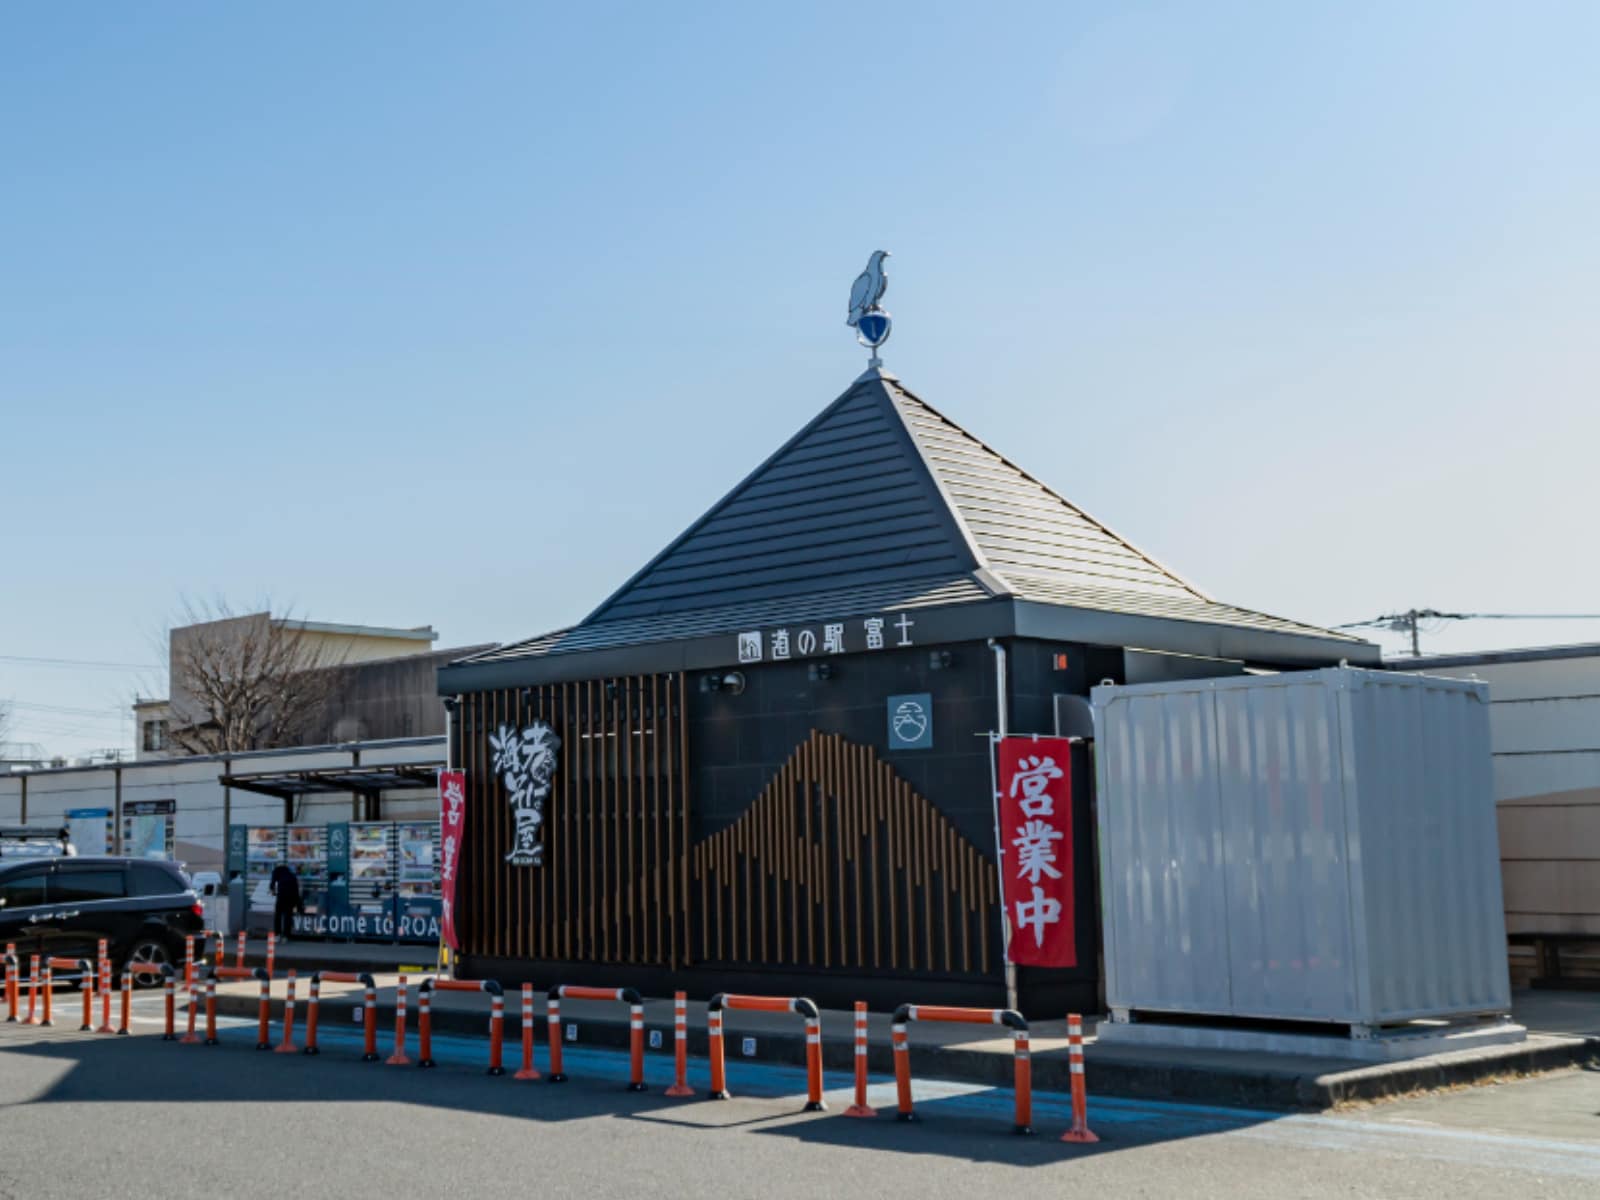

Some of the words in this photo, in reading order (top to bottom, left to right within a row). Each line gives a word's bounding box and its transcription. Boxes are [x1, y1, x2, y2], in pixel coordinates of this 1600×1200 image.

[771, 623, 846, 660] 道の駅
[863, 612, 915, 650] 富士
[1009, 755, 1065, 949] 営業中
[374, 916, 394, 935] to
[400, 915, 440, 937] ROA
